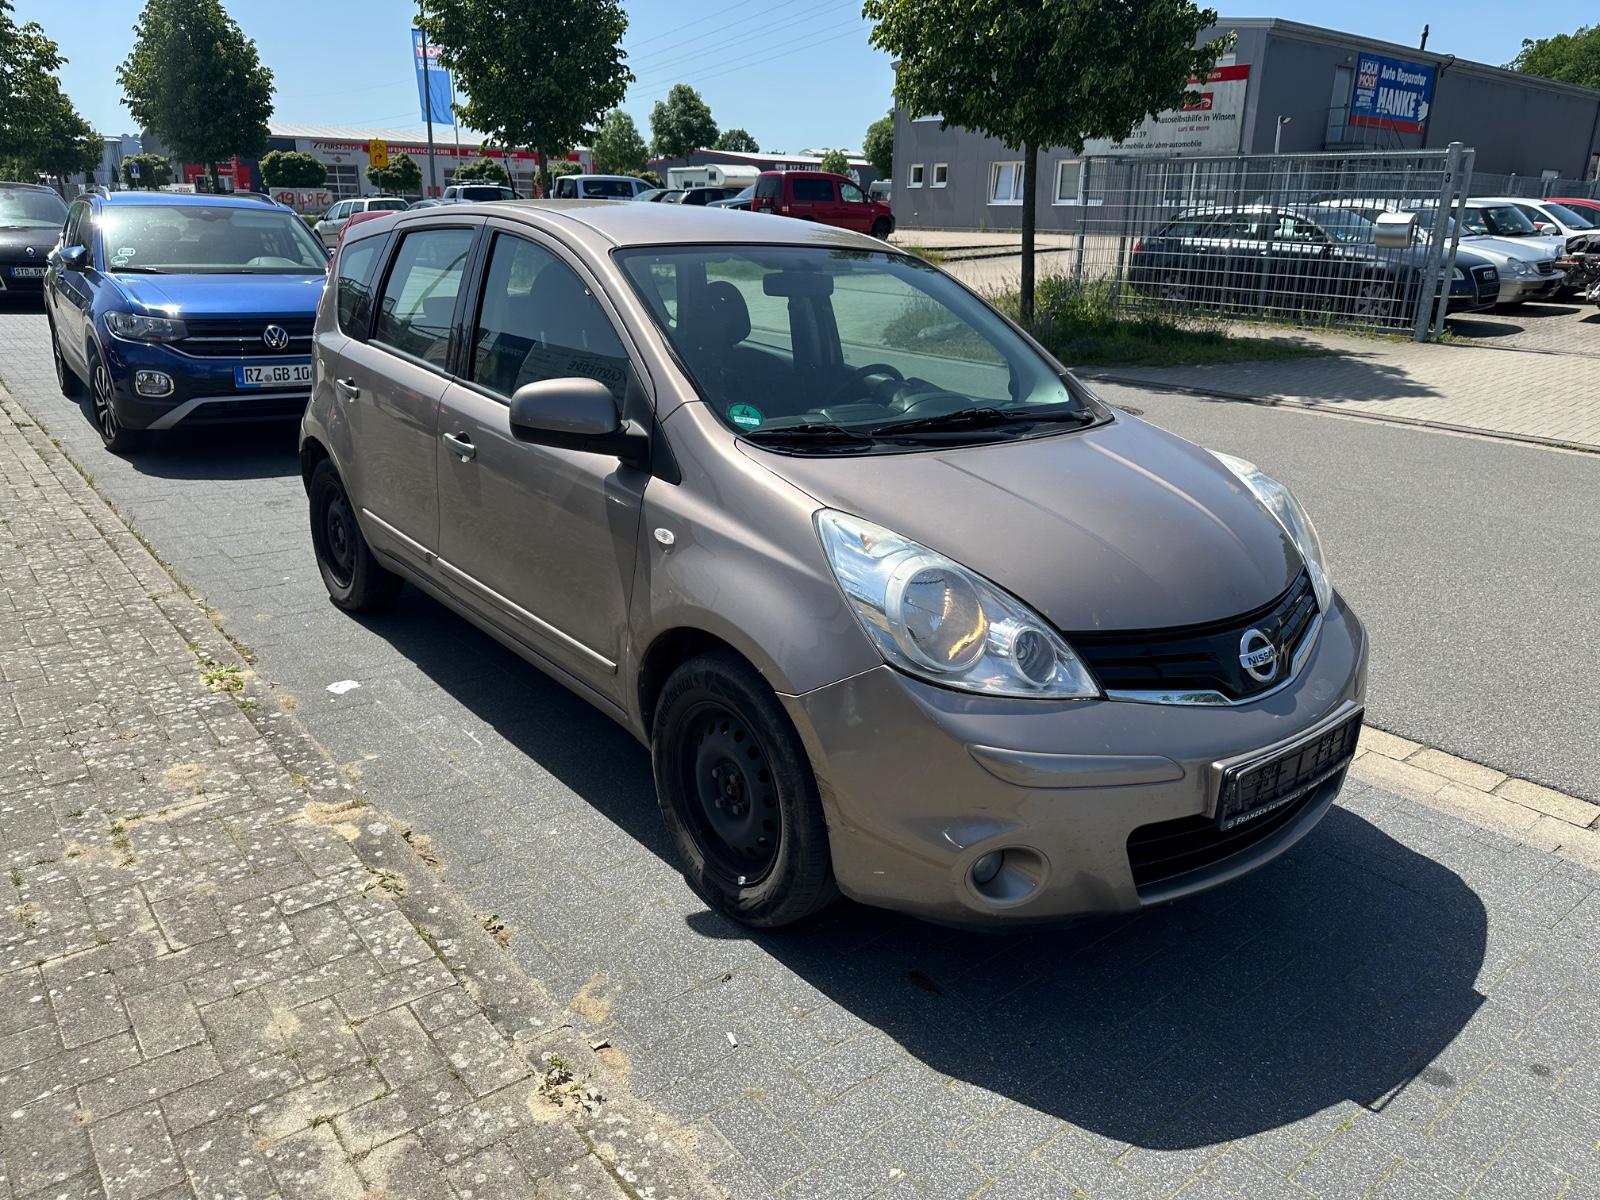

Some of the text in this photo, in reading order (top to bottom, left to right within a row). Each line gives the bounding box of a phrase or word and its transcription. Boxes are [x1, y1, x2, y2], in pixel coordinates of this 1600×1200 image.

[1360, 61, 1379, 74] LIQUI
[1359, 74, 1377, 87] MOLY
[1381, 65, 1427, 86] Auto Reparatur
[1376, 87, 1418, 117] HANKE
[1203, 114, 1210, 122] in
[1212, 113, 1236, 121] Winsen
[1445, 172, 1451, 183] 3
[244, 366, 312, 382] RZ GB 10
[1236, 808, 1267, 825] FRANZEN
